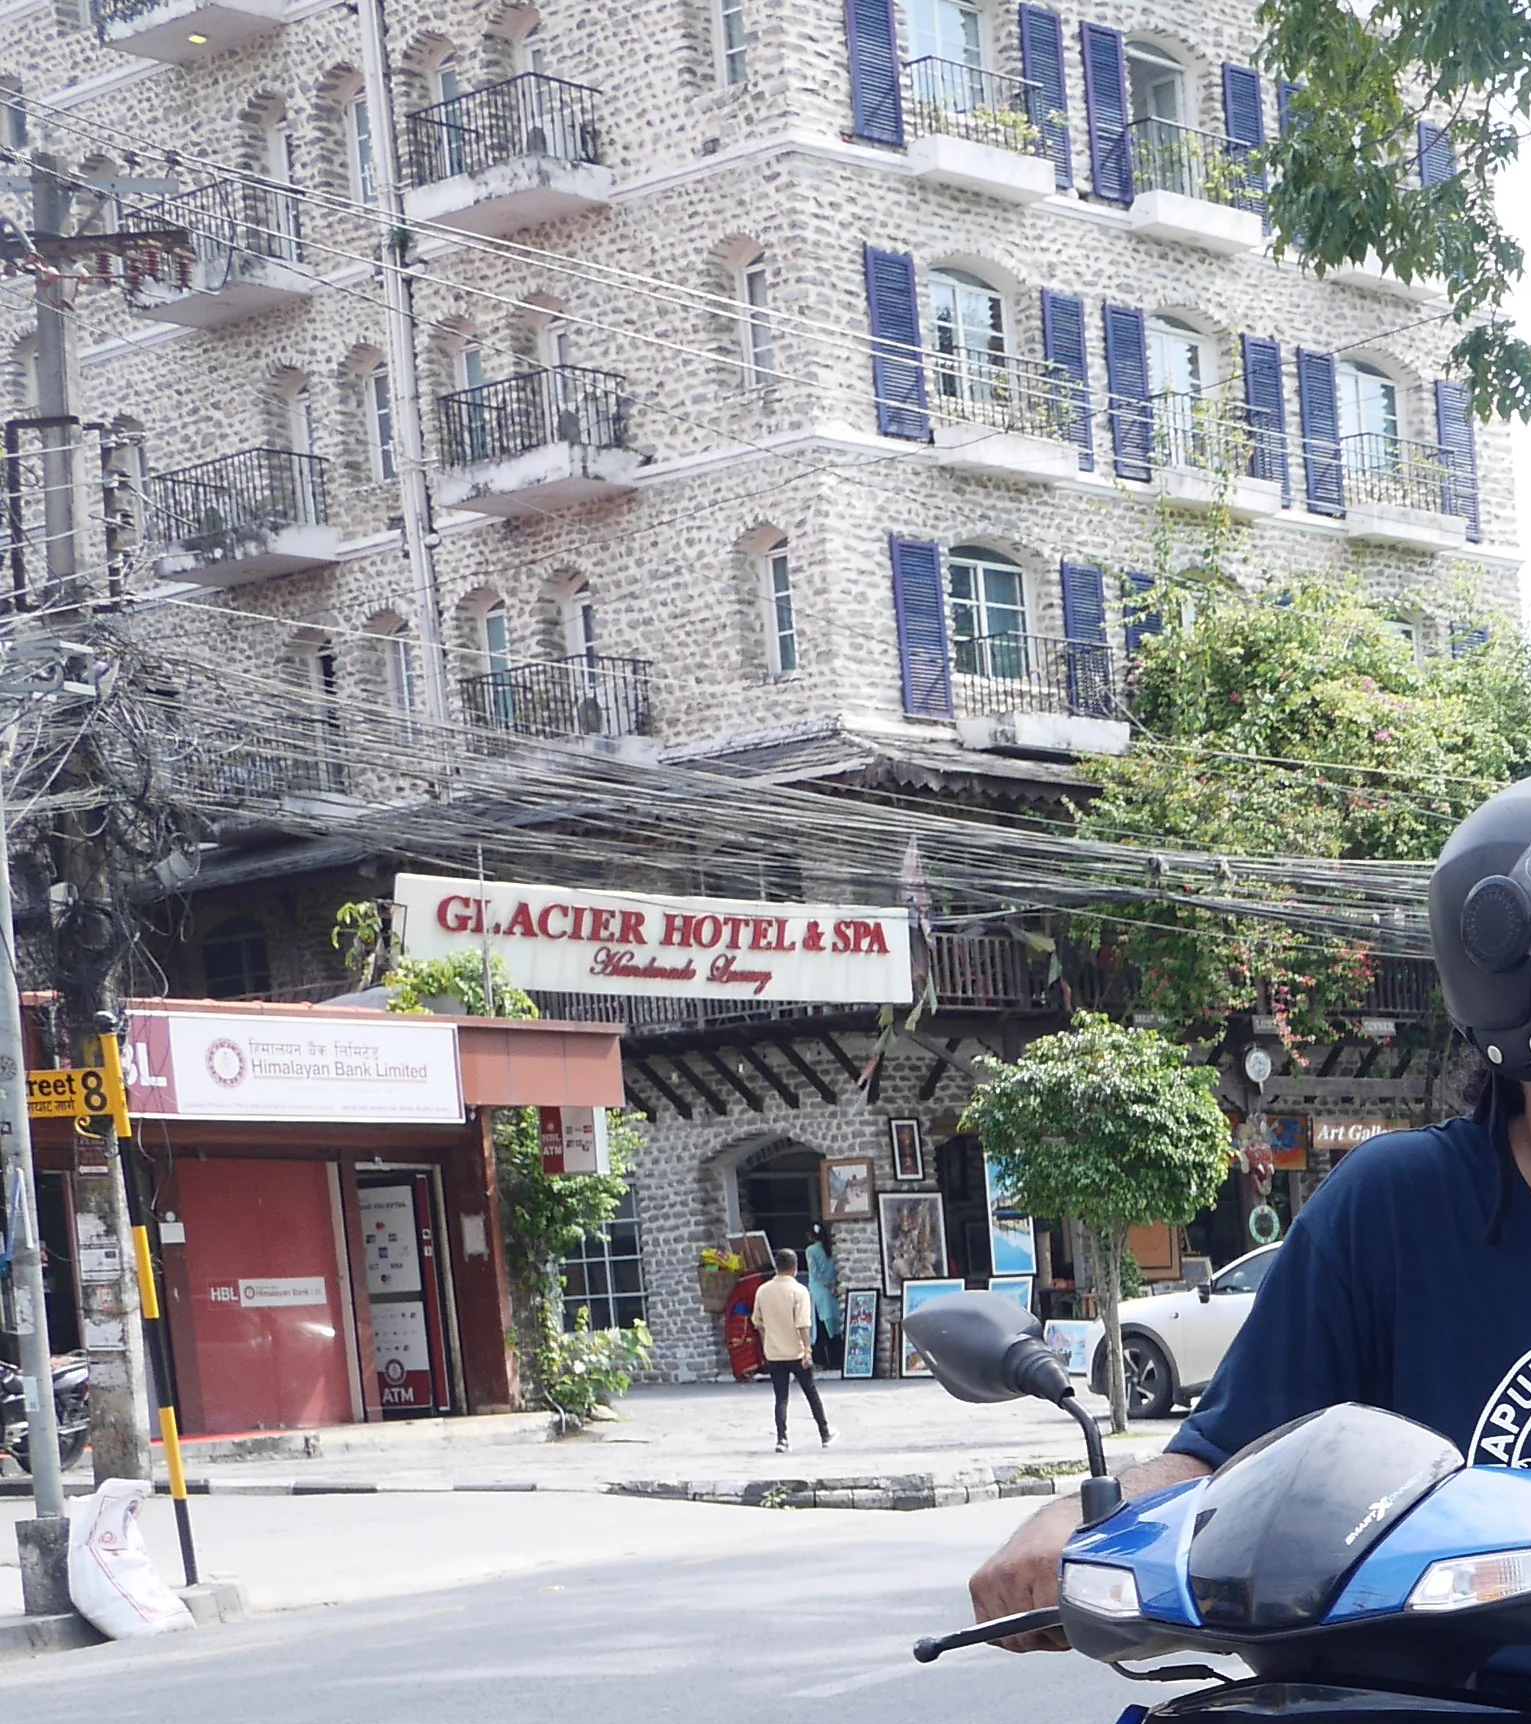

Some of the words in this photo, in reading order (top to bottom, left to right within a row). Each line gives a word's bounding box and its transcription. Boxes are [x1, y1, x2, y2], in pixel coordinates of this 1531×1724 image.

[436, 895, 647, 946] GLACIER
[659, 912, 797, 951] HOTEL
[803, 920, 826, 953] &
[832, 920, 890, 954] SPA
[121, 1041, 168, 1088] BL
[251, 1059, 330, 1080] Himalayan
[335, 1061, 372, 1077] Bank
[376, 1063, 428, 1079] Limited
[27, 1073, 77, 1098] reet
[81, 1070, 108, 1113] 8
[1318, 1124, 1345, 1140] Art
[210, 1287, 239, 1301] HBL
[382, 1387, 415, 1404] ATM
